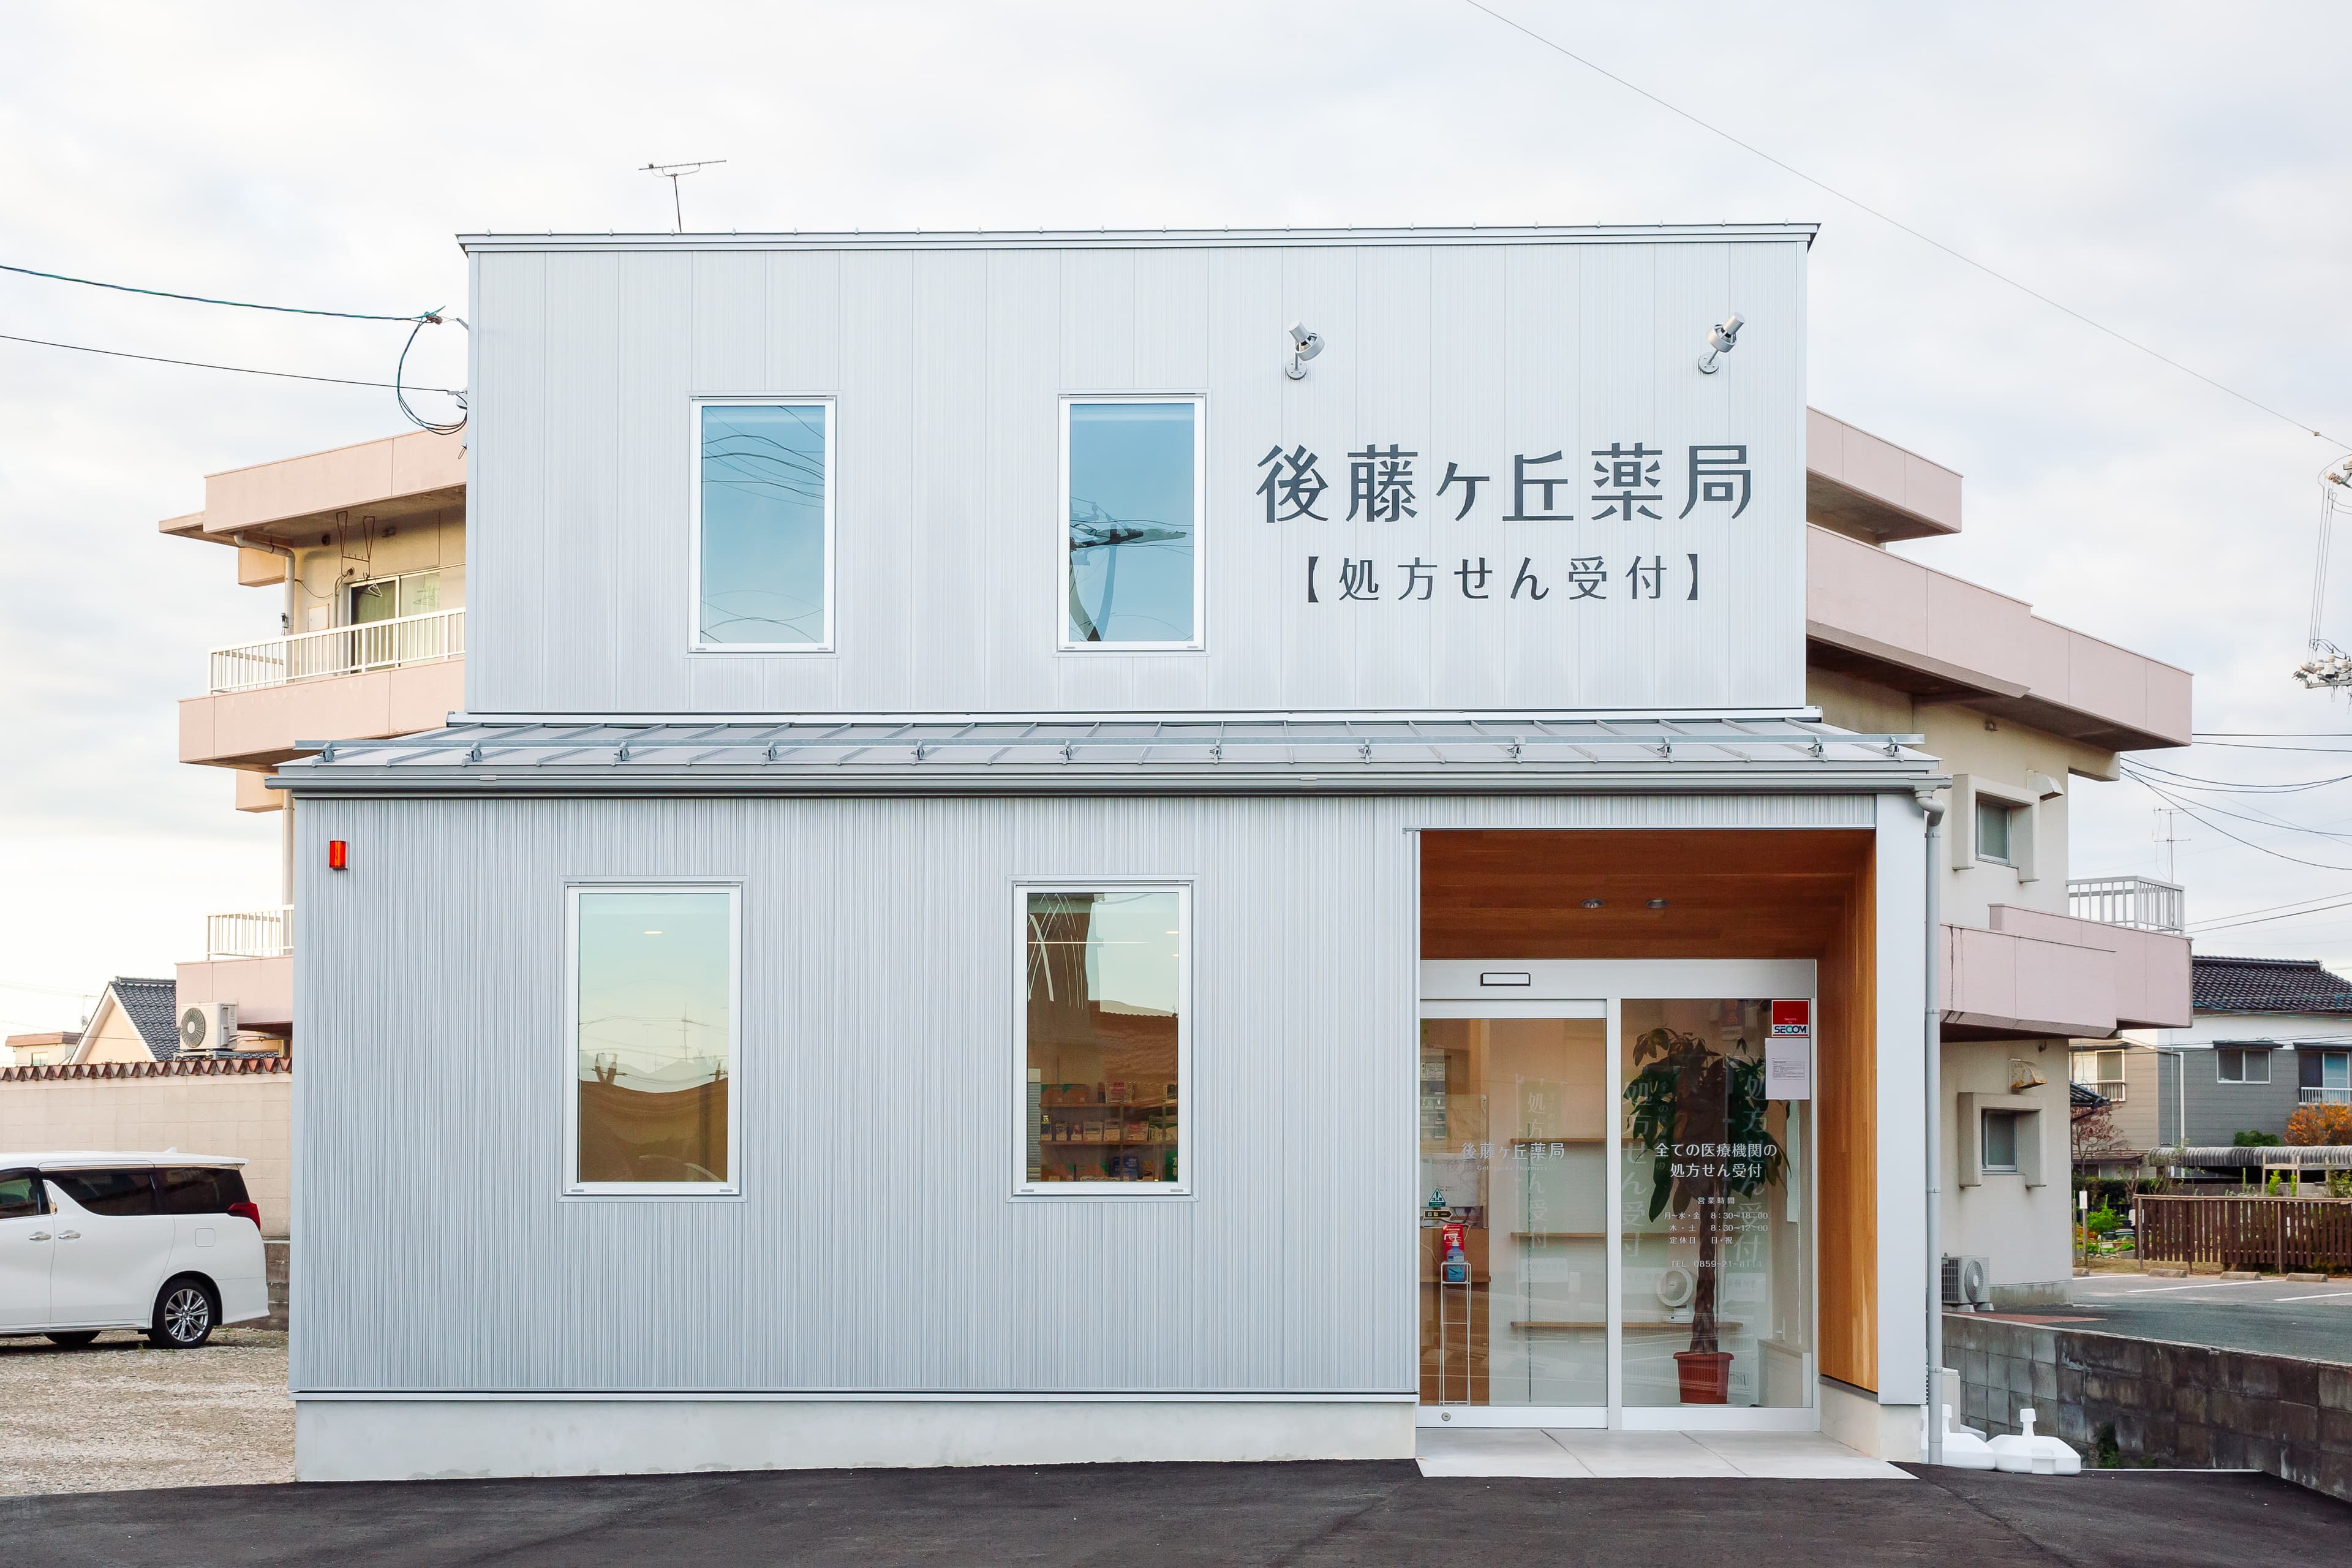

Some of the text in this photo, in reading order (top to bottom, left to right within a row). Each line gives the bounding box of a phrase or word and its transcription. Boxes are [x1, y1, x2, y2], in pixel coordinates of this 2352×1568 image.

[1307, 553, 1699, 603] 【処方せん受付】
[1654, 1143, 1777, 1158] 全ての医療機関の
[1670, 1163, 1762, 1178] 処方せん受付
[1697, 1196, 1736, 1205] 営業時間
